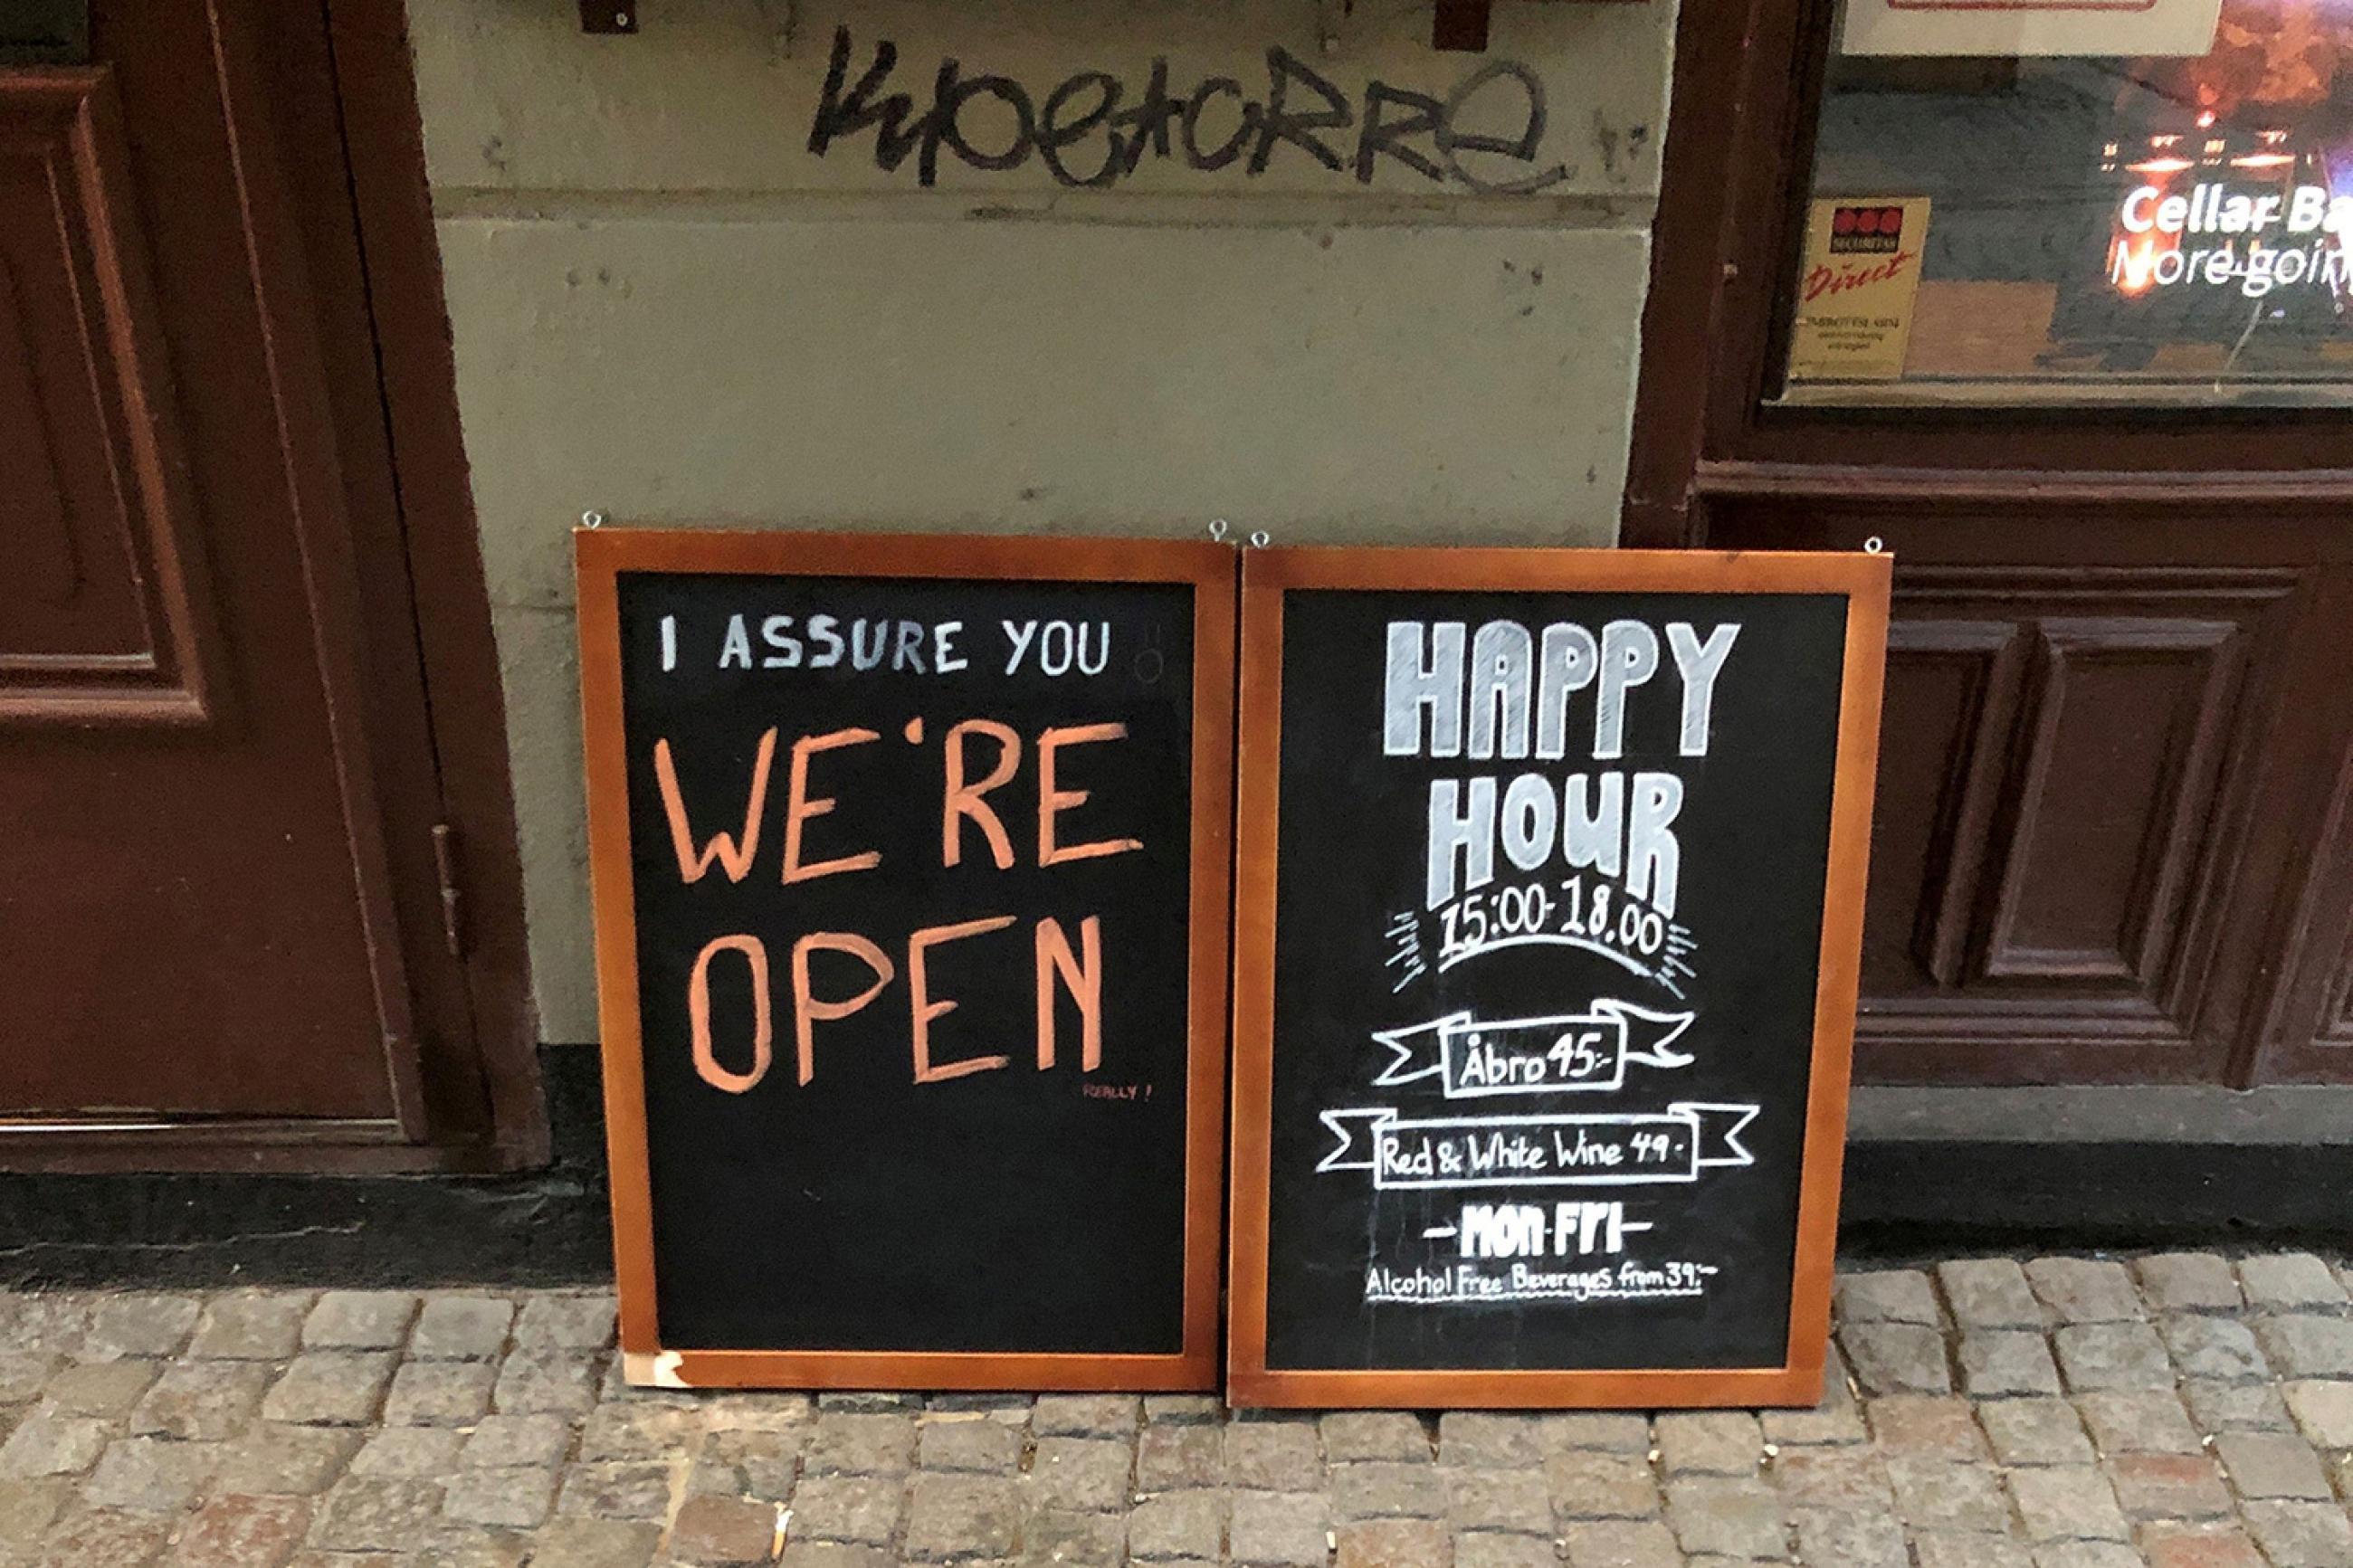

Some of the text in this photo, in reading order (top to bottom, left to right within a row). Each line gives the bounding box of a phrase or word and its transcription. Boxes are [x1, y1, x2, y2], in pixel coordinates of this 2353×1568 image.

[2121, 183, 2281, 233] Cellar
[1805, 251, 1918, 302] Direct
[2111, 238, 2353, 298] More goin
[661, 614, 1110, 677] I ASSURE YOU
[1384, 620, 1742, 760] HAPPY
[654, 717, 1144, 885] WE'RE
[1426, 771, 1684, 919] HOUR
[689, 915, 1102, 1094] OPEN
[1460, 1032, 1546, 1086] Åbro
[1382, 1136, 1434, 1175] Red
[1437, 1139, 1462, 1174] &
[1468, 1131, 1548, 1171] White
[1554, 1130, 1624, 1168] Wine
[1365, 1266, 1452, 1295] Alcohol
[1457, 1266, 1503, 1294] Free
[1511, 1263, 1612, 1300] Beverages
[1617, 1261, 1663, 1291] from
